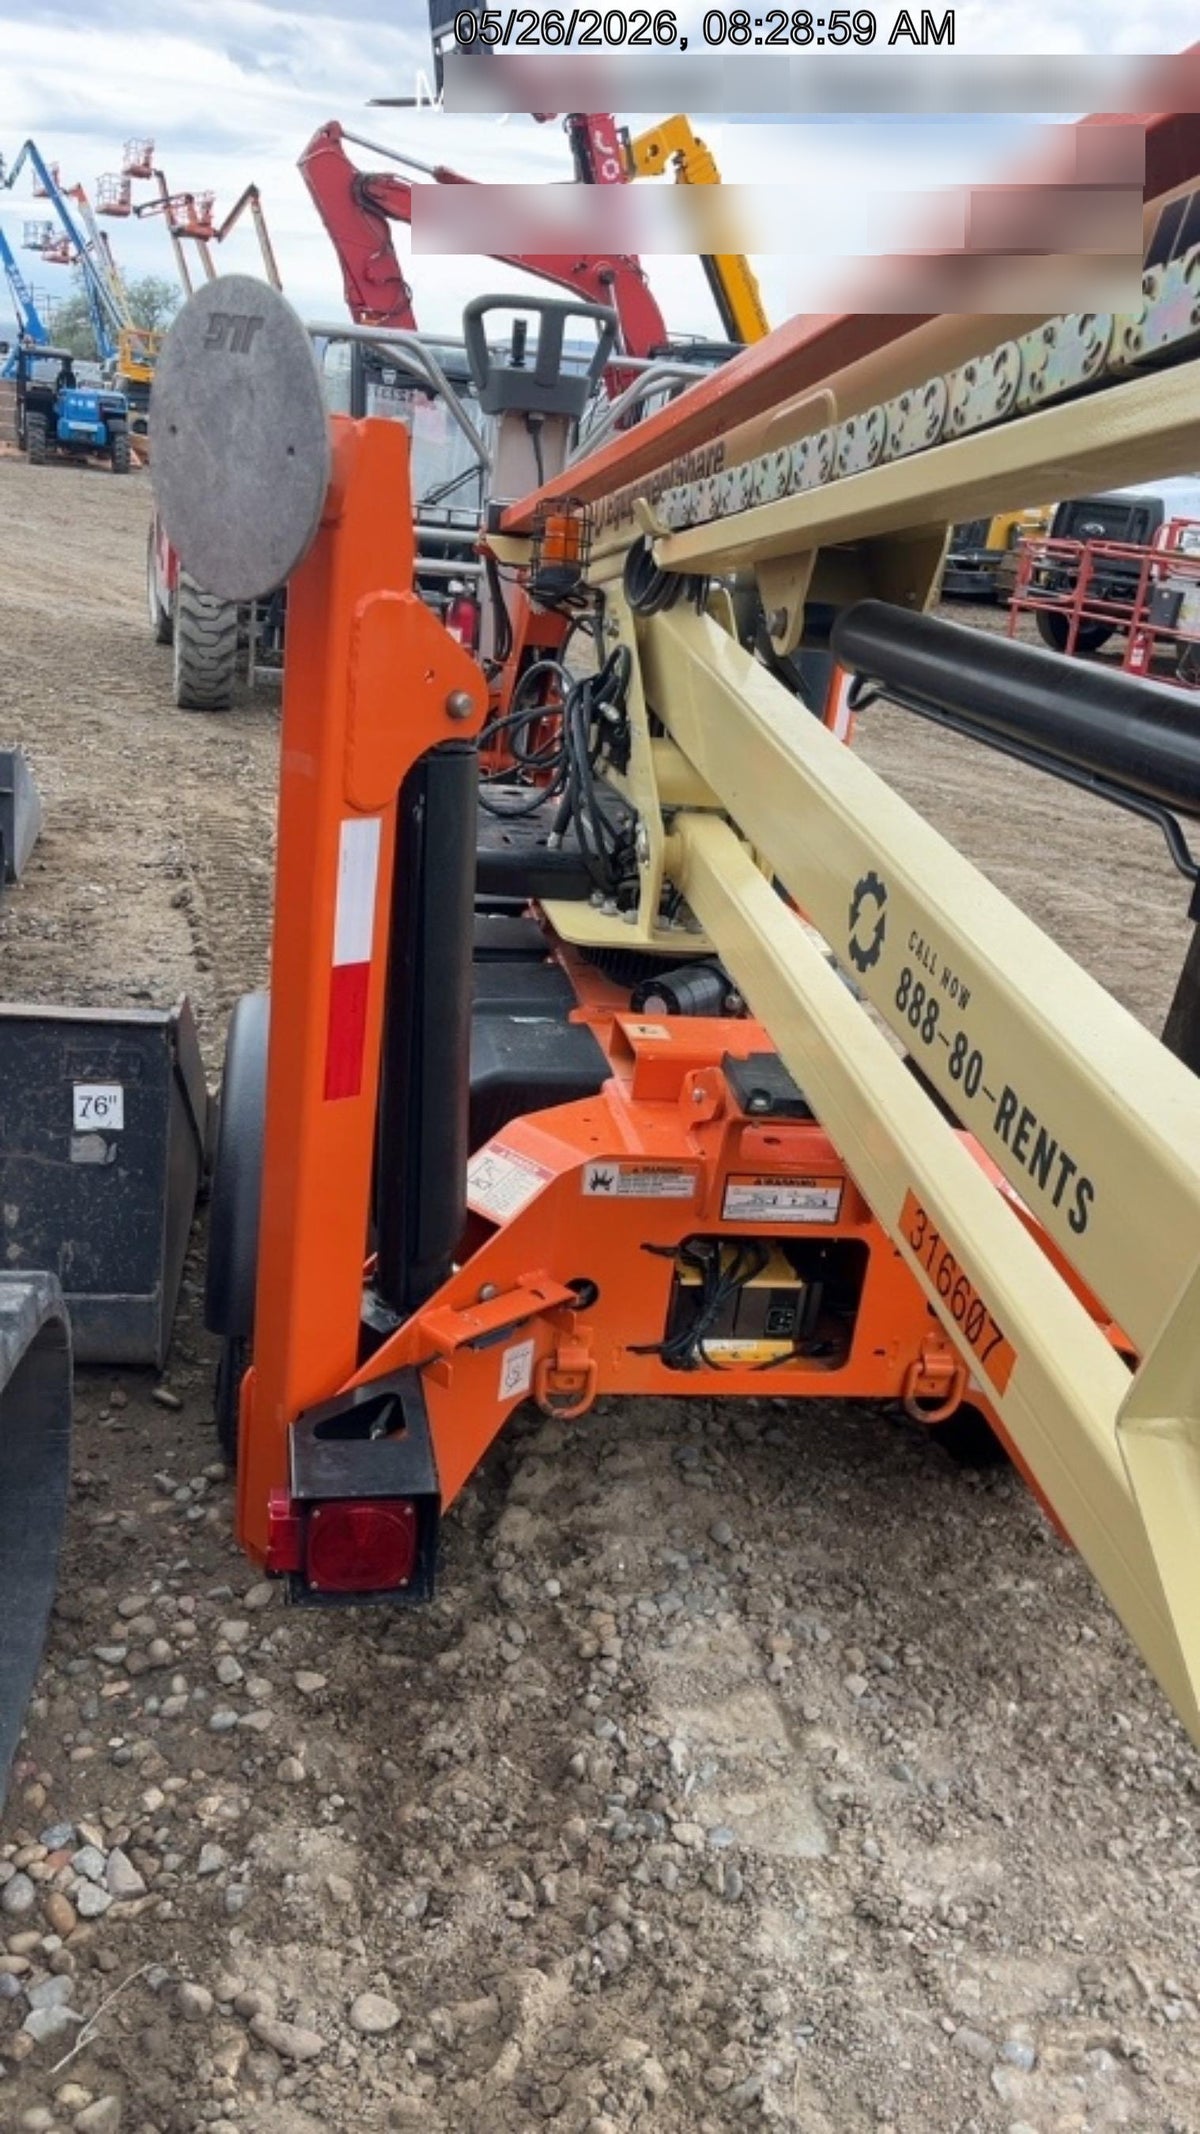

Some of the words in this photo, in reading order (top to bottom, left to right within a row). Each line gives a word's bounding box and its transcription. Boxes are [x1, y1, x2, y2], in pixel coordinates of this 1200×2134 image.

[908, 929, 938, 976] CALL
[940, 966, 971, 1011] NOW
[78, 1094, 117, 1119] 76"
[895, 967, 1094, 1235] 888-80-RENTS
[909, 1207, 1005, 1364] 316607
